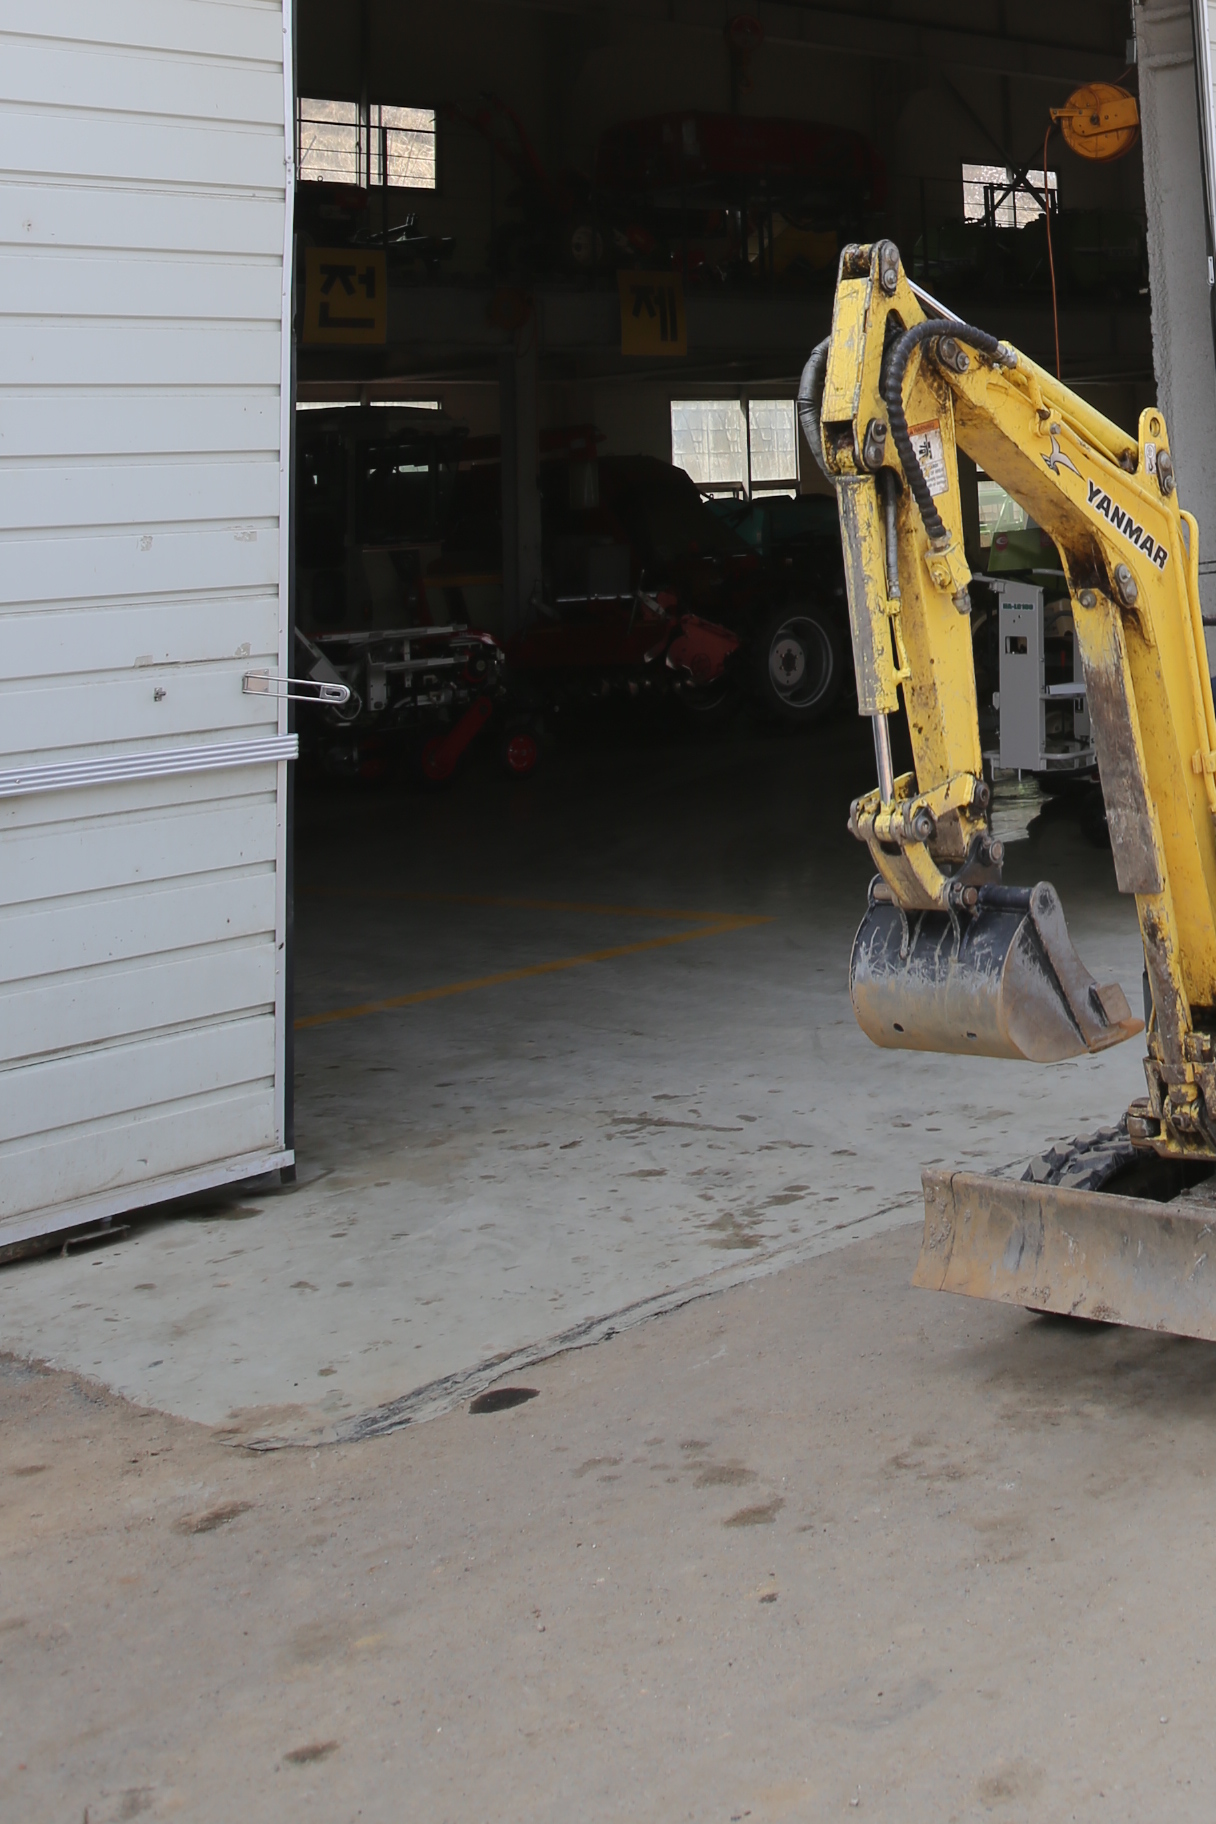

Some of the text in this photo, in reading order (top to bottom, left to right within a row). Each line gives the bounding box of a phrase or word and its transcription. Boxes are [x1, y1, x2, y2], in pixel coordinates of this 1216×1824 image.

[318, 263, 679, 343] 전 제
[1087, 480, 1169, 570] YANMAR
